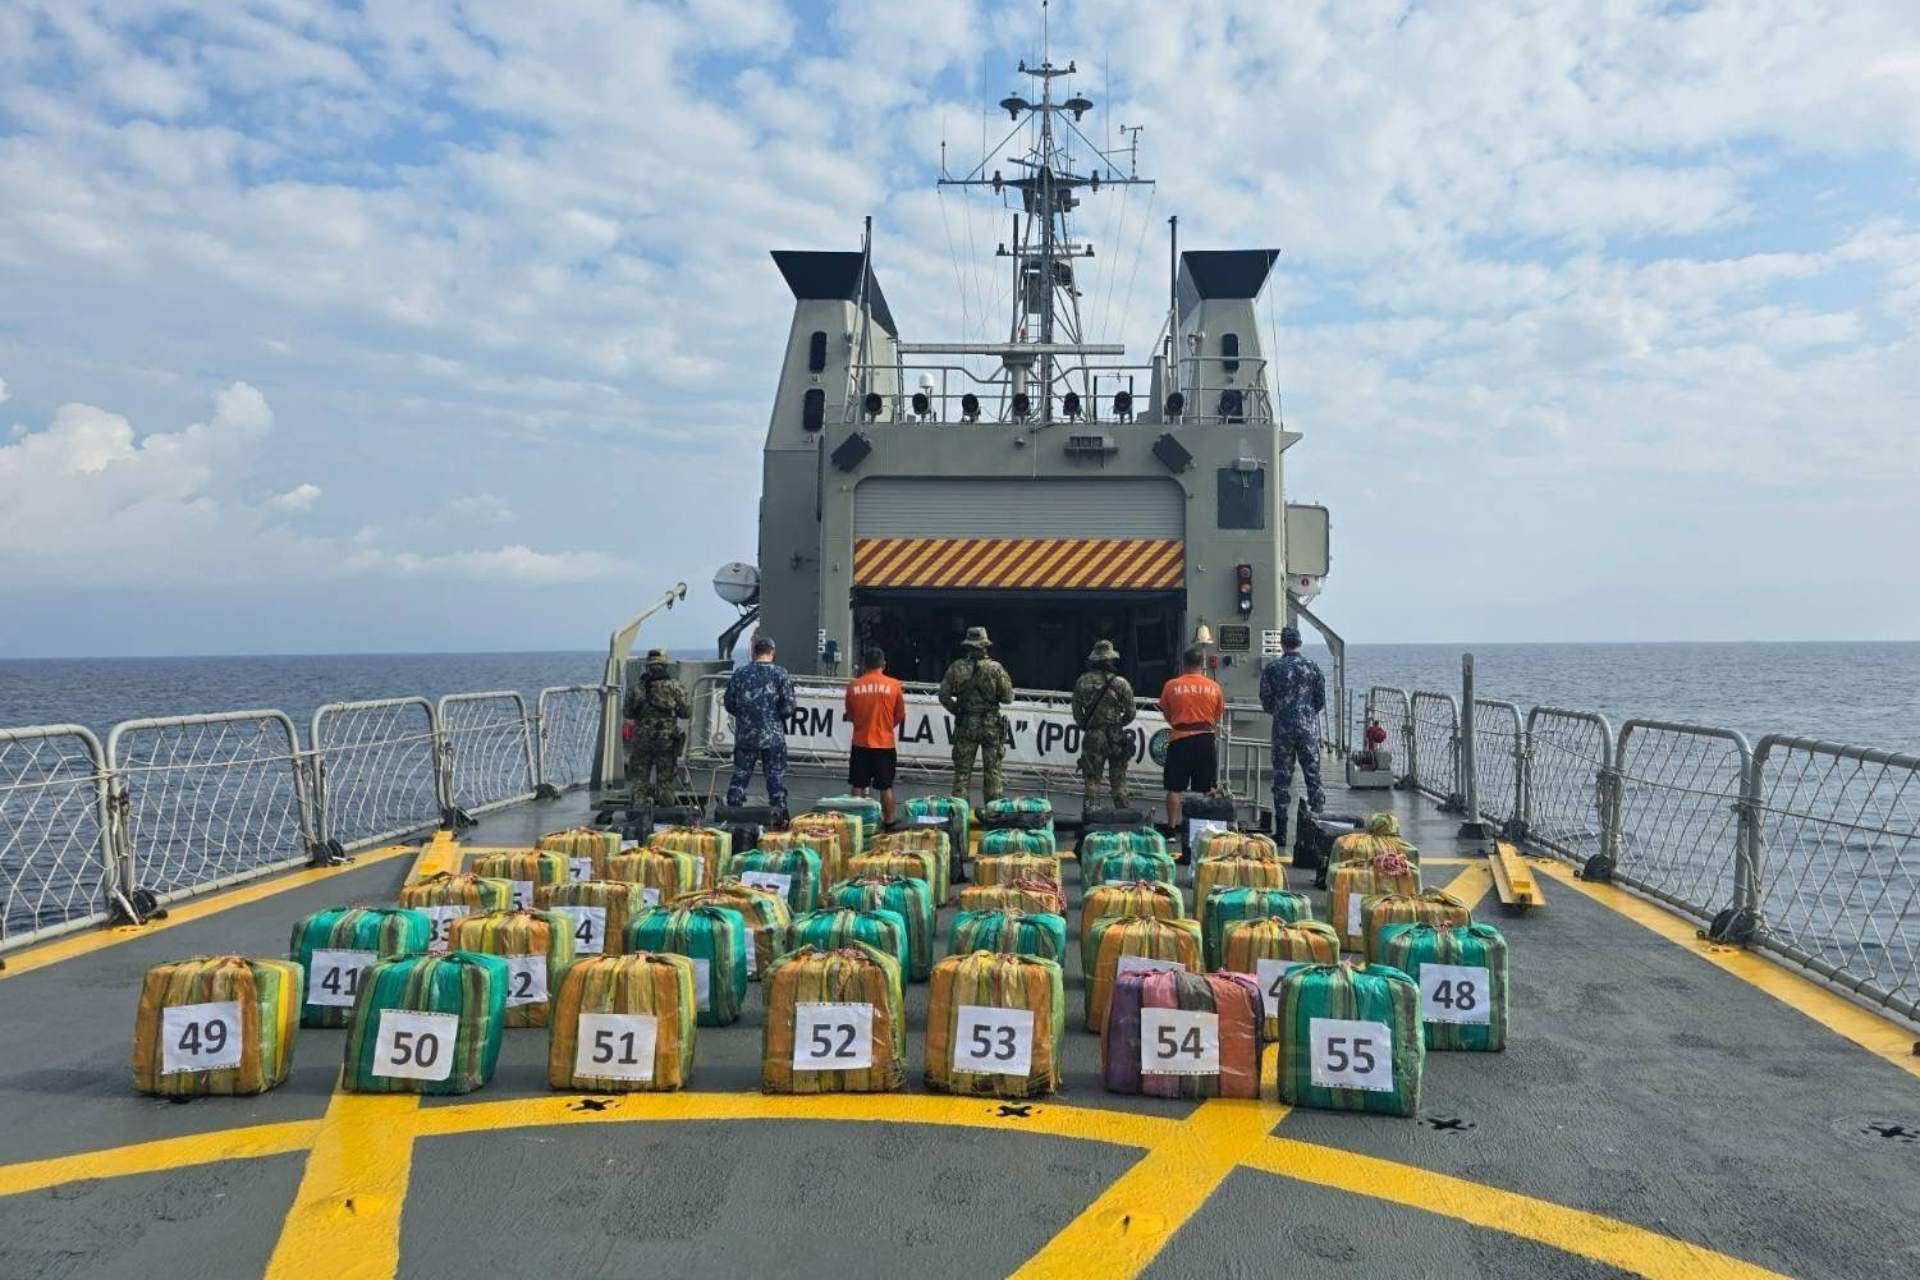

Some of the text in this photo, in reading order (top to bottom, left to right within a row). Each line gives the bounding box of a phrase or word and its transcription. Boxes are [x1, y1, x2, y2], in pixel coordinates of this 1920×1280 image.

[853, 683, 891, 695] MARINA
[1174, 684, 1216, 696] MARINA
[320, 967, 357, 996] 41
[1432, 979, 1476, 1011] 48
[178, 1019, 227, 1055] 49
[390, 1031, 439, 1068] 50
[592, 1030, 638, 1065] 51
[810, 1023, 857, 1058] 52
[970, 1023, 1016, 1061] 53
[1156, 1025, 1205, 1060] 54
[1326, 1037, 1375, 1074] 55
